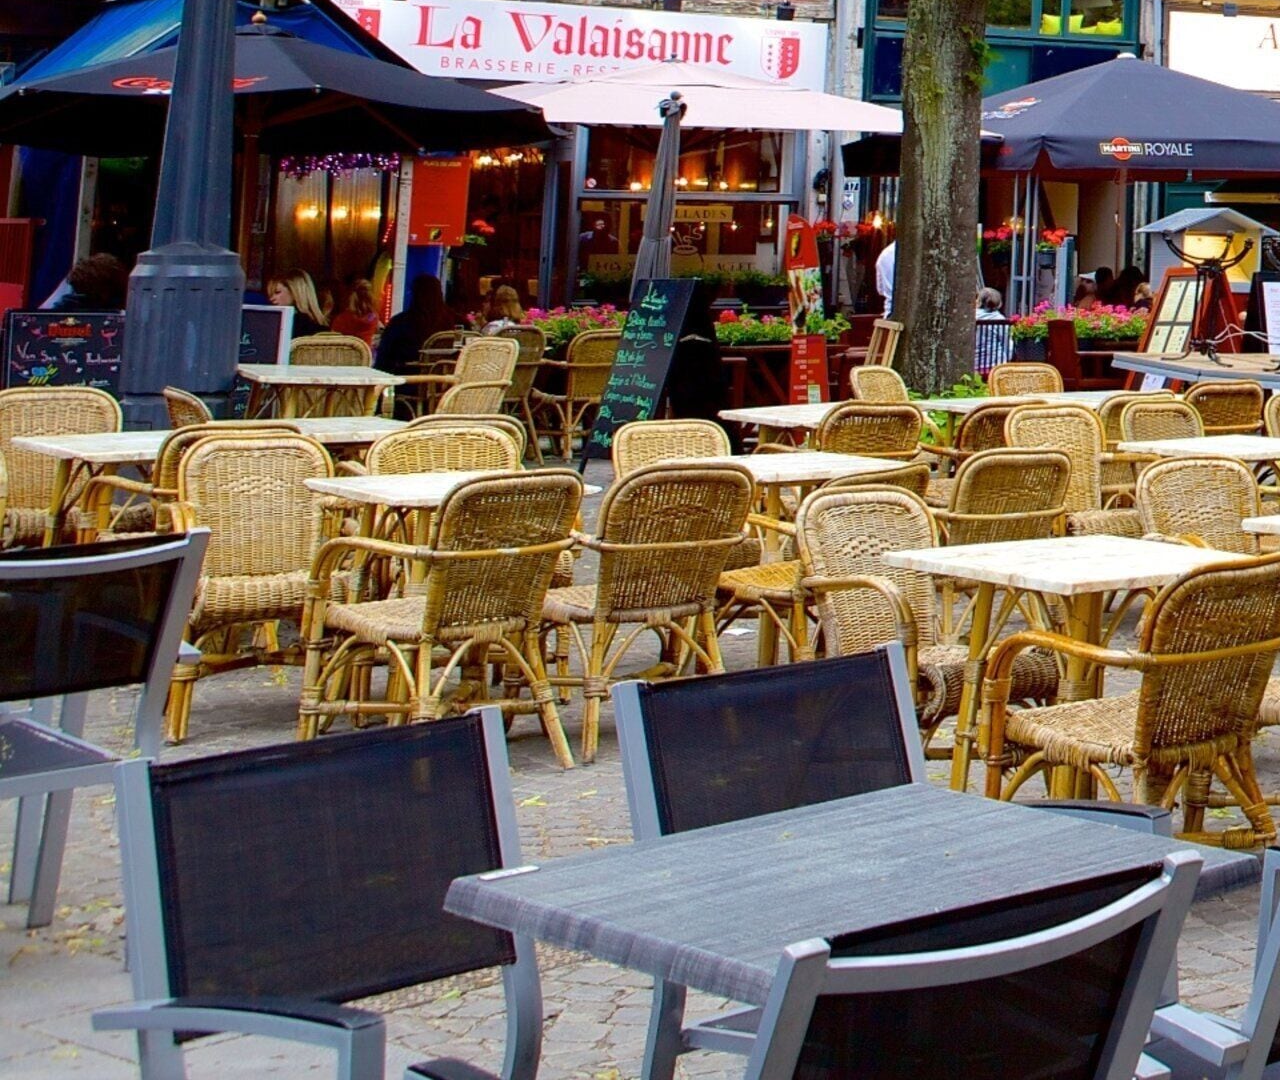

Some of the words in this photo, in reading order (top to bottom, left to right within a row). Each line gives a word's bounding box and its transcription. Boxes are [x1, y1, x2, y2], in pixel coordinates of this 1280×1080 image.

[410, 3, 482, 51] La
[505, 11, 735, 66] Valaisanne
[440, 56, 556, 75] BRASSERIE
[1101, 143, 1142, 155] MARTINI
[1144, 142, 1194, 157] ROYALE
